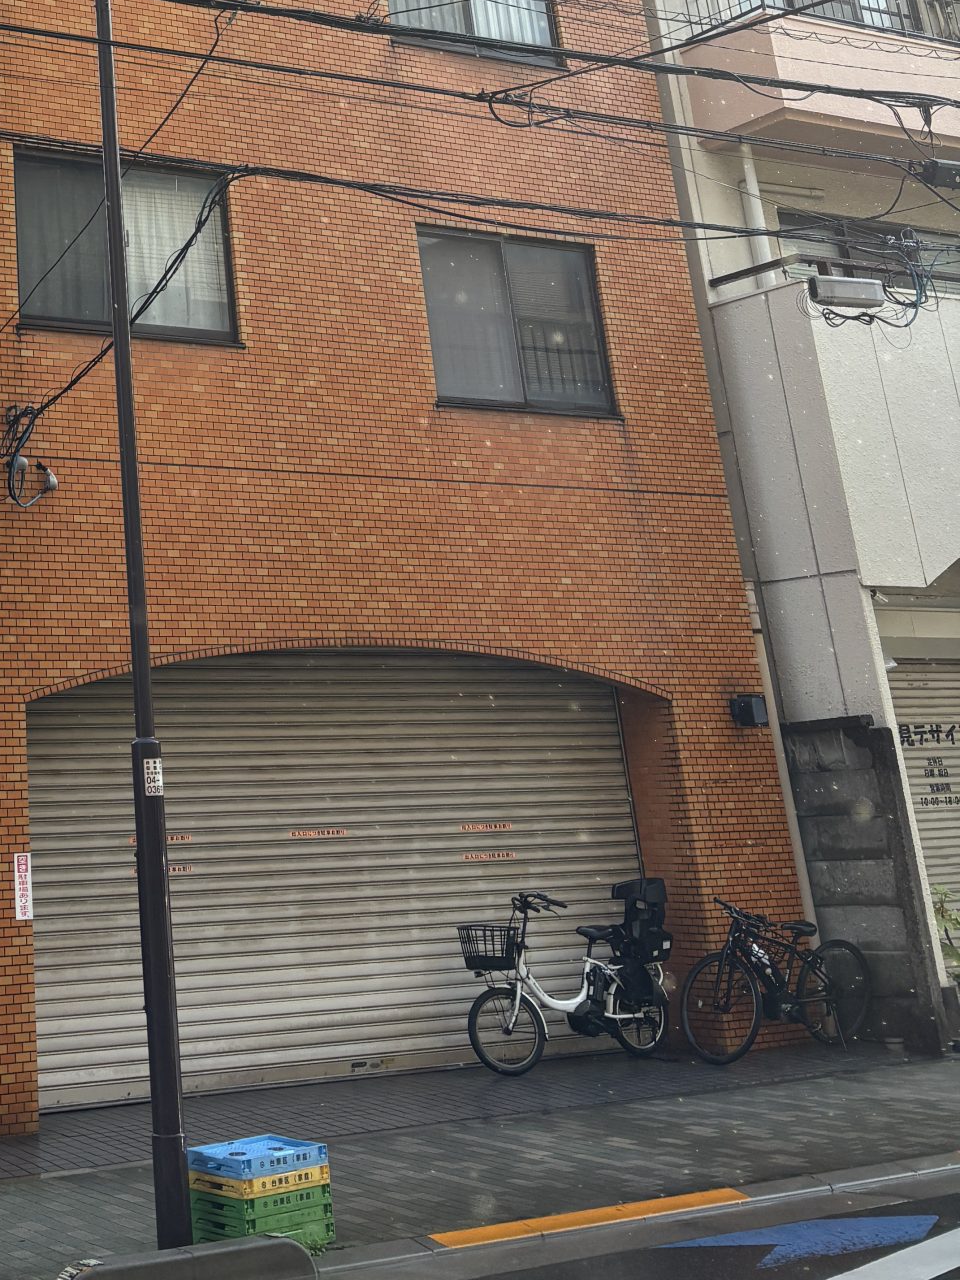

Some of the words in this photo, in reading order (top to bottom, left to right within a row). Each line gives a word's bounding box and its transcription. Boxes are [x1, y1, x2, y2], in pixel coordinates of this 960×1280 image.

[270, 1156, 288, 1167] 台東区
[272, 1176, 290, 1187] 台東区
[273, 1196, 291, 1207] 台東区
